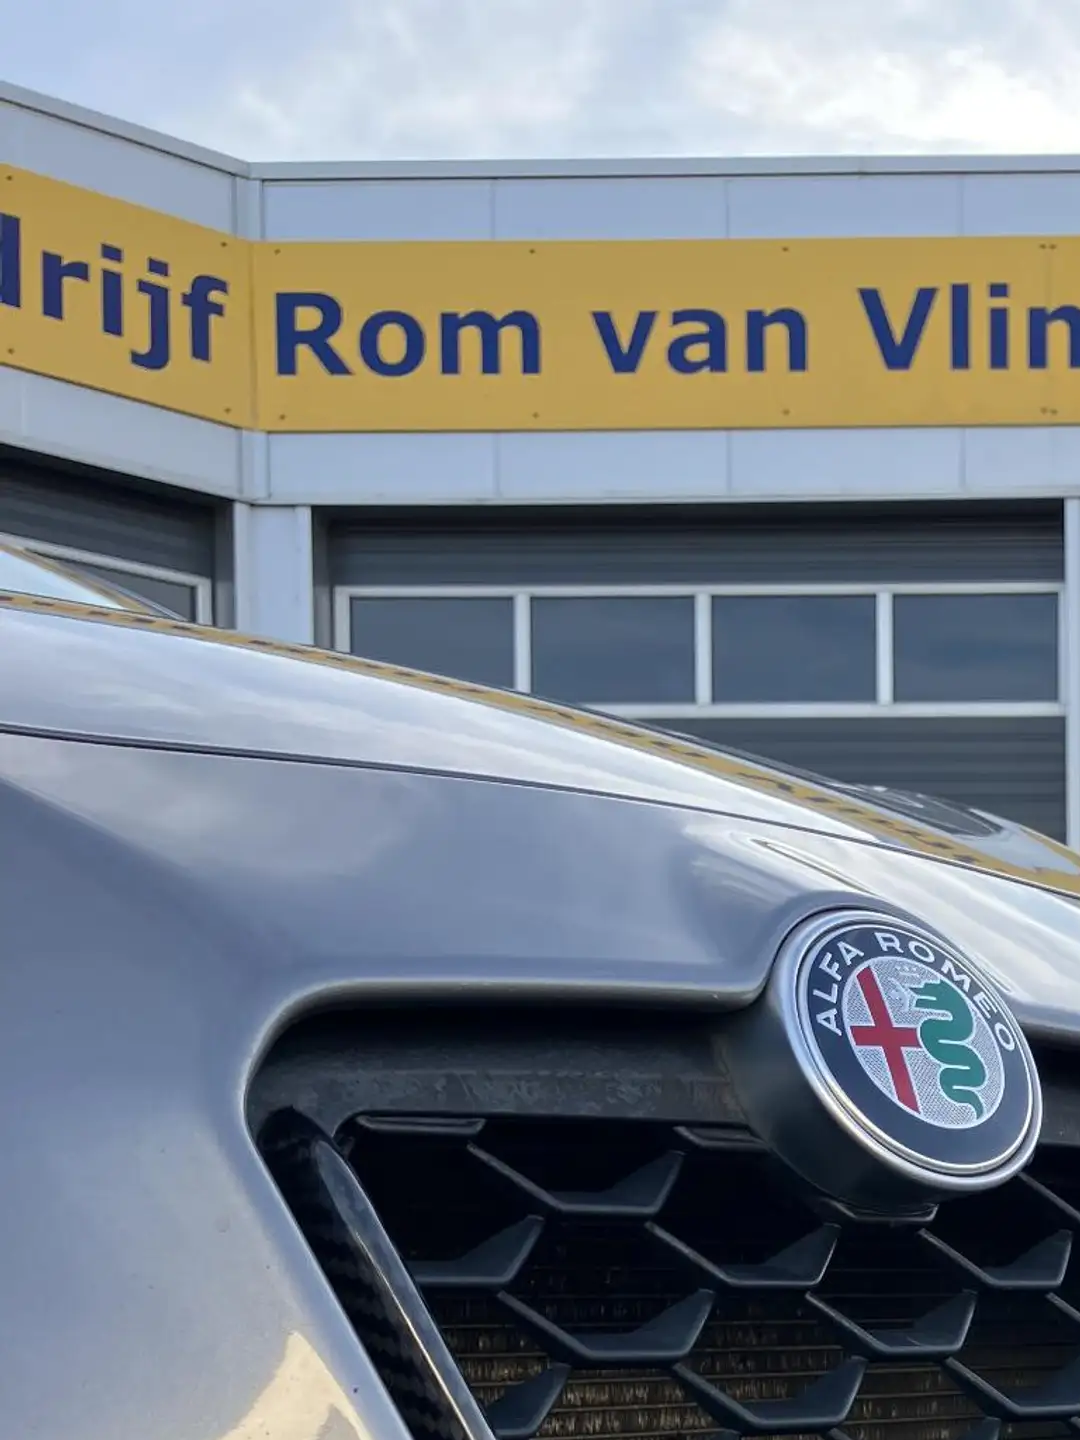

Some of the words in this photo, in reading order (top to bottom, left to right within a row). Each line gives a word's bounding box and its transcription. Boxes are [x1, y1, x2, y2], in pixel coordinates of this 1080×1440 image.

[275, 291, 541, 377] Rom
[592, 307, 808, 375] van
[815, 940, 865, 1036] ALFA
[874, 931, 1016, 1053] ROMEO
